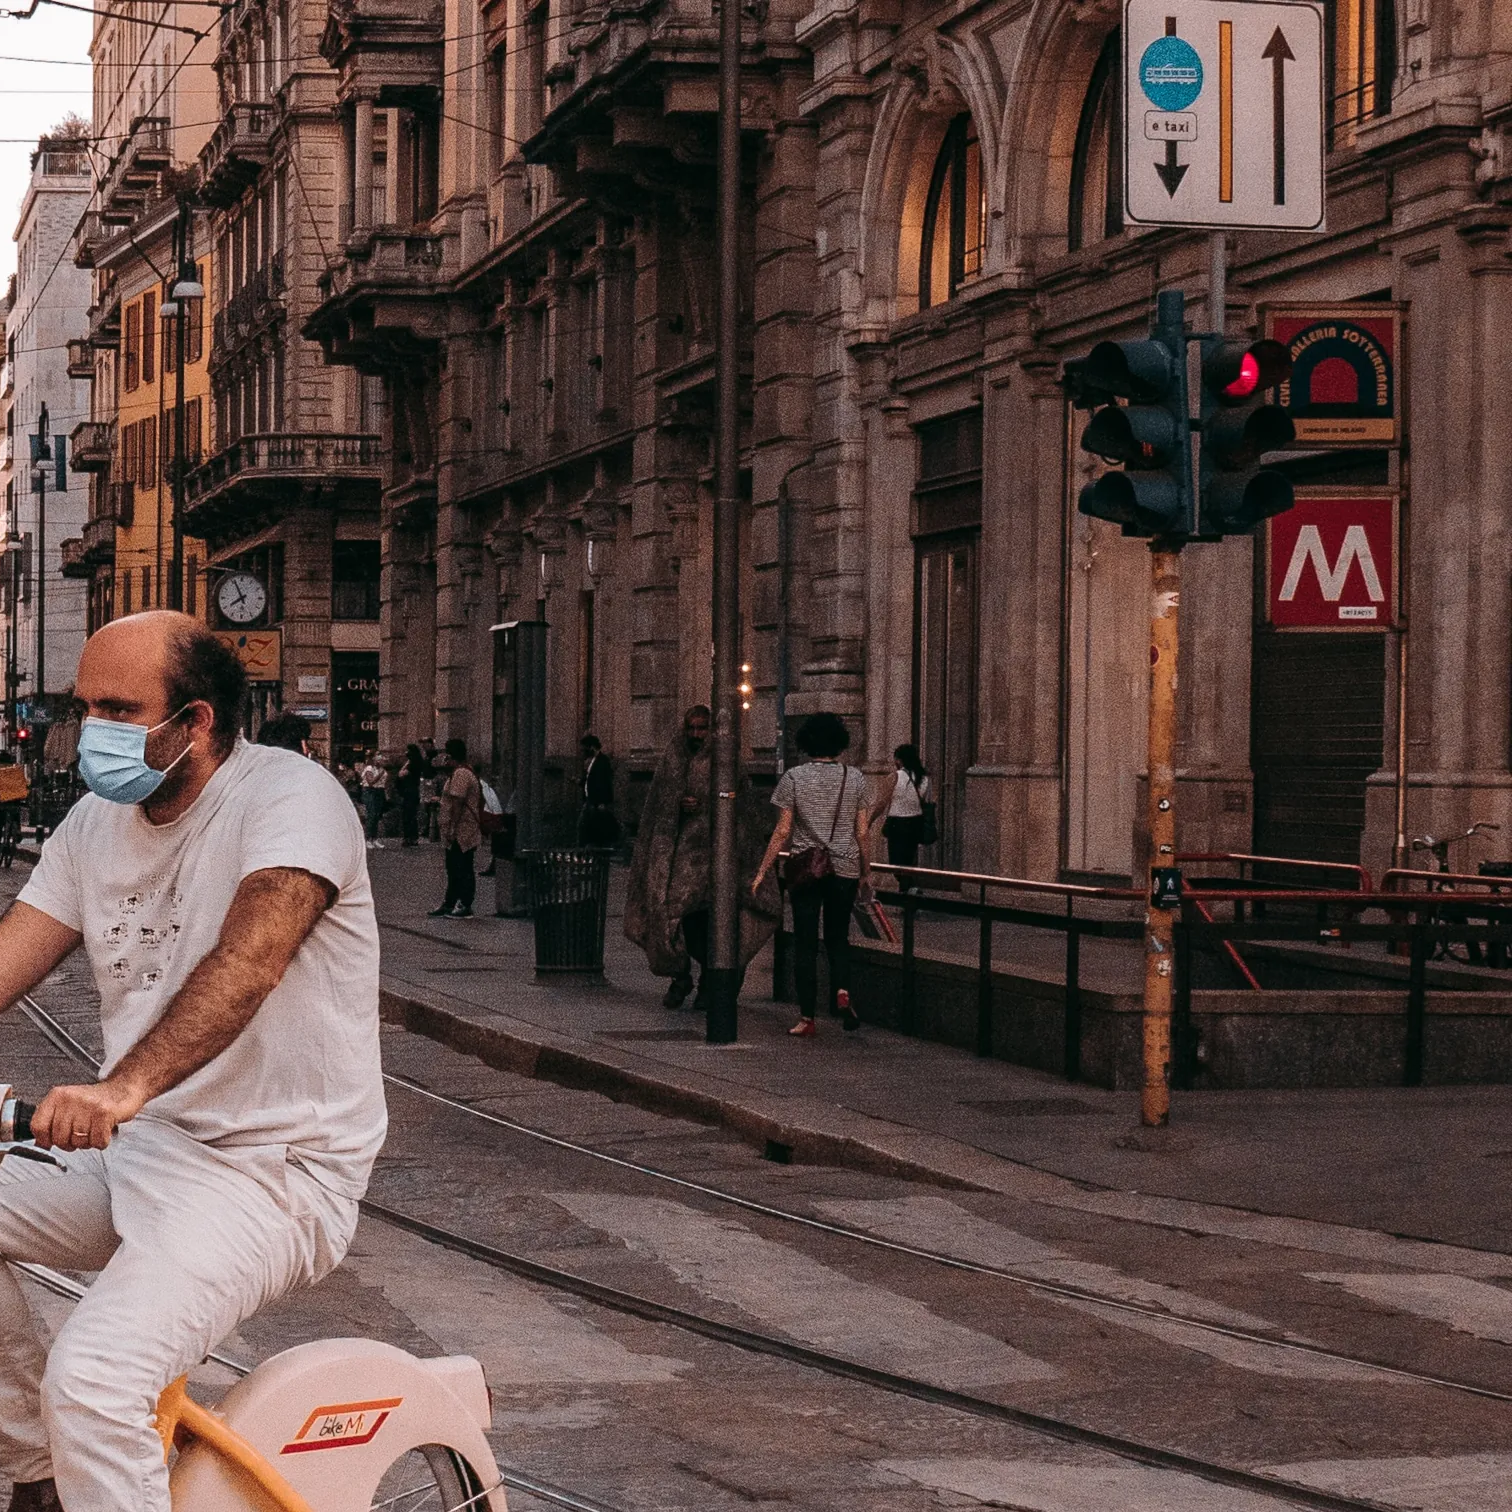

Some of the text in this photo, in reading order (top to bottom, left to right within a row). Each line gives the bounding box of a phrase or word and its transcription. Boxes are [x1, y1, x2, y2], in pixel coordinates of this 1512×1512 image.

[1152, 121, 1189, 132] e taxi
[1278, 525, 1385, 602] M
